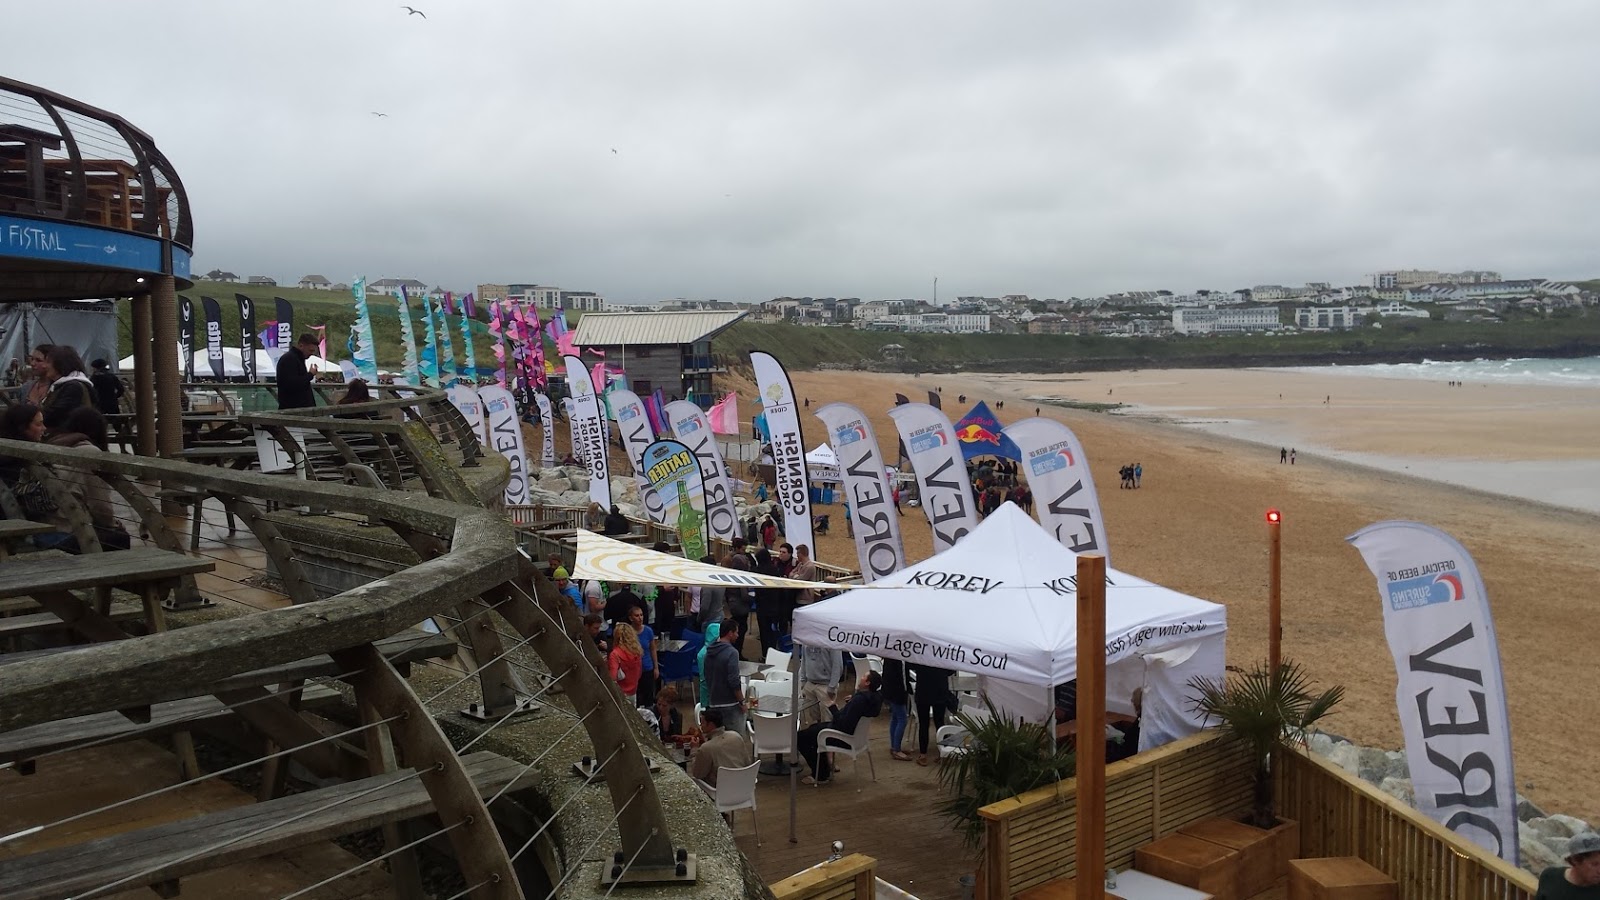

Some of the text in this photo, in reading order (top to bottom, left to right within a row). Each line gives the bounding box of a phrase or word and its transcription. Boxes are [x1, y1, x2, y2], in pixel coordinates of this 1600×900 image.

[9, 225, 67, 251] FISTRAL
[906, 571, 1004, 594] KOREV
[1159, 623, 1182, 637] with
[828, 626, 1008, 670] Cornish Lager with Soul
